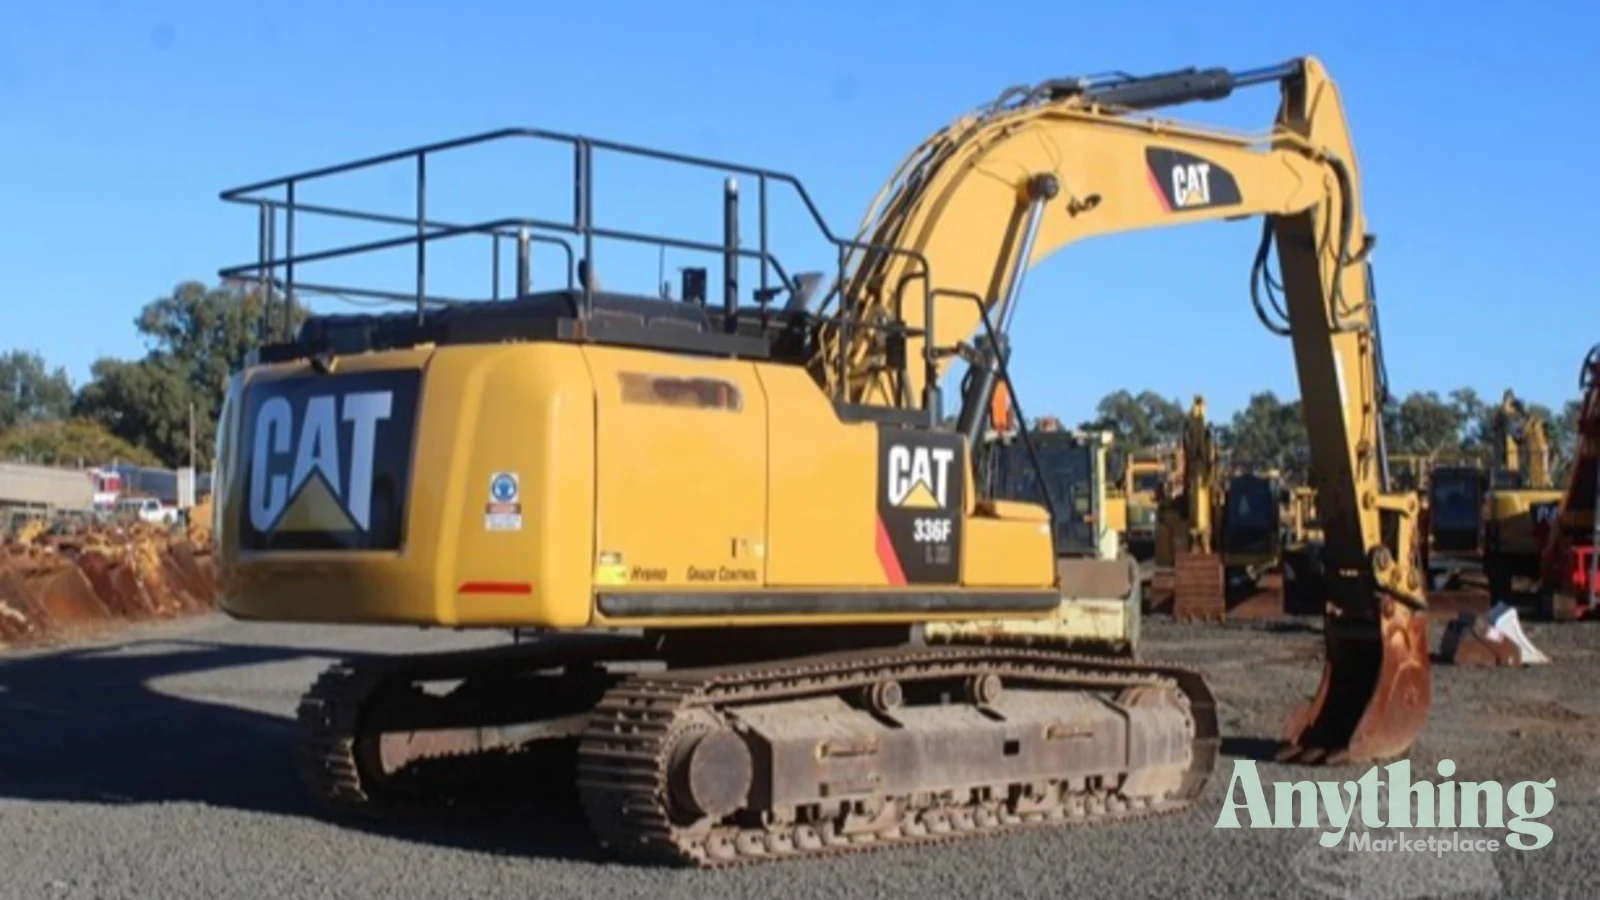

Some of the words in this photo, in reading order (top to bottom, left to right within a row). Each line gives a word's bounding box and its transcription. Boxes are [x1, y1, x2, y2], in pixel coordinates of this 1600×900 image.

[1172, 163, 1210, 207] CAT
[249, 390, 393, 532] CAT
[888, 444, 954, 508] CAT
[913, 518, 952, 543] 336F
